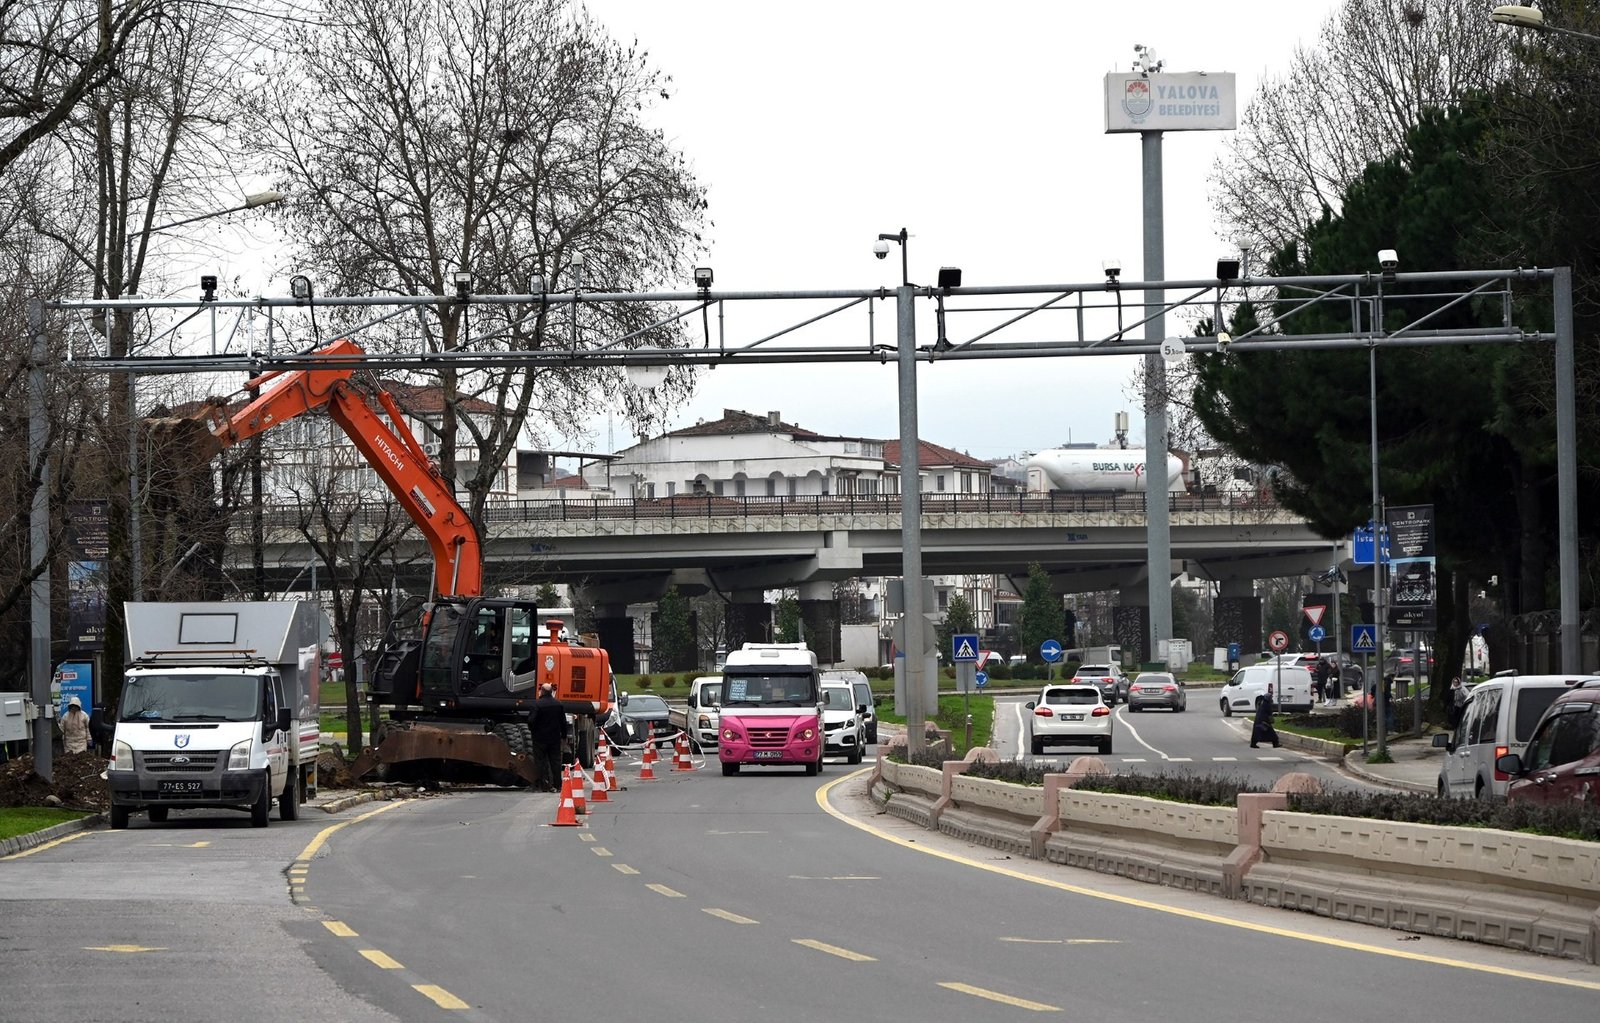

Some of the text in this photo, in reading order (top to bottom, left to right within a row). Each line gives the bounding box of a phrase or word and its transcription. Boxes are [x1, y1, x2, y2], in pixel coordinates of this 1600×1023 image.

[1157, 85, 1219, 99] YALOVA
[1159, 101, 1220, 116] BELEDİYESİ
[374, 435, 405, 471] HITACHI
[1092, 462, 1121, 471] BURSA
[163, 782, 201, 790] 77 ES 527
